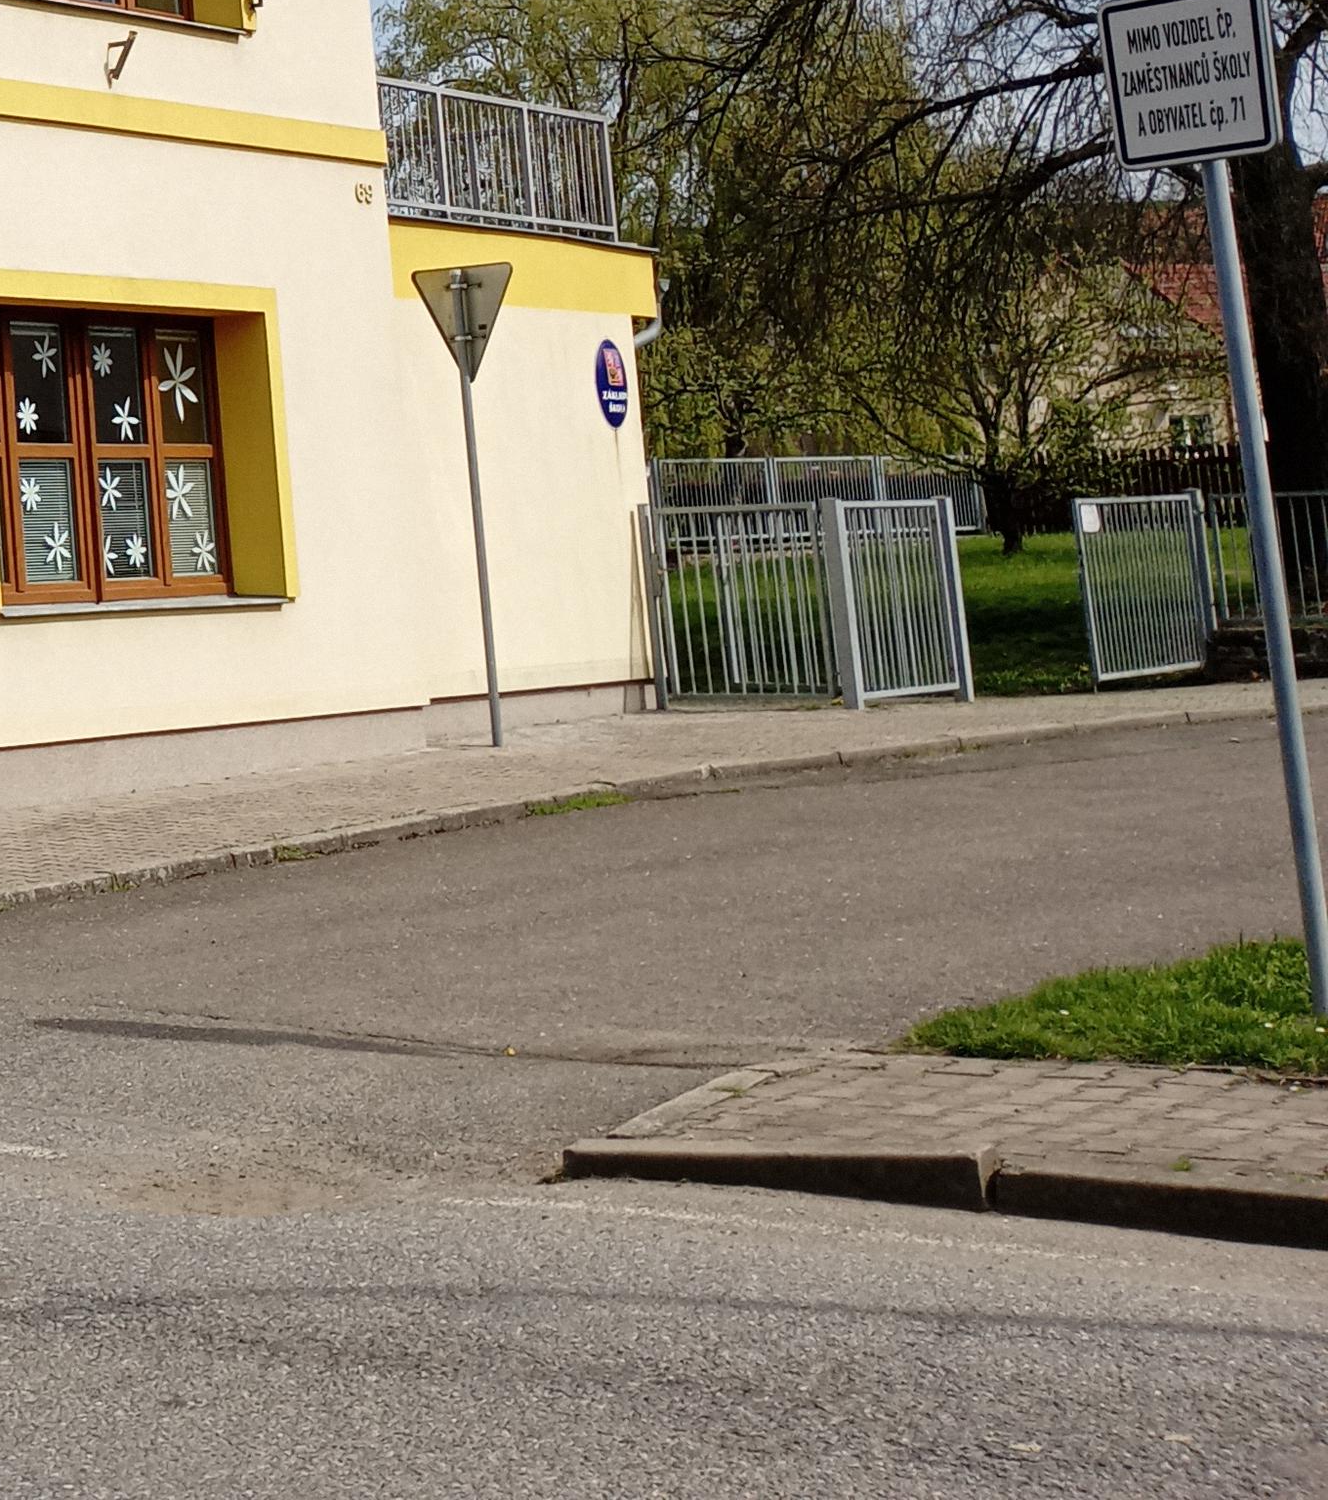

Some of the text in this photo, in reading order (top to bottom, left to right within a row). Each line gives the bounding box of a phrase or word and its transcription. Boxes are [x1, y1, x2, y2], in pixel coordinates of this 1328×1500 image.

[1126, 24, 1161, 55] MIMO
[1162, 16, 1215, 48] VOZIDEL
[1122, 51, 1251, 97] ZAMĚSTNANCŮ ŠKOLY
[1138, 96, 1246, 137] A OBYVATEL čp. 71
[354, 182, 373, 205] 69
